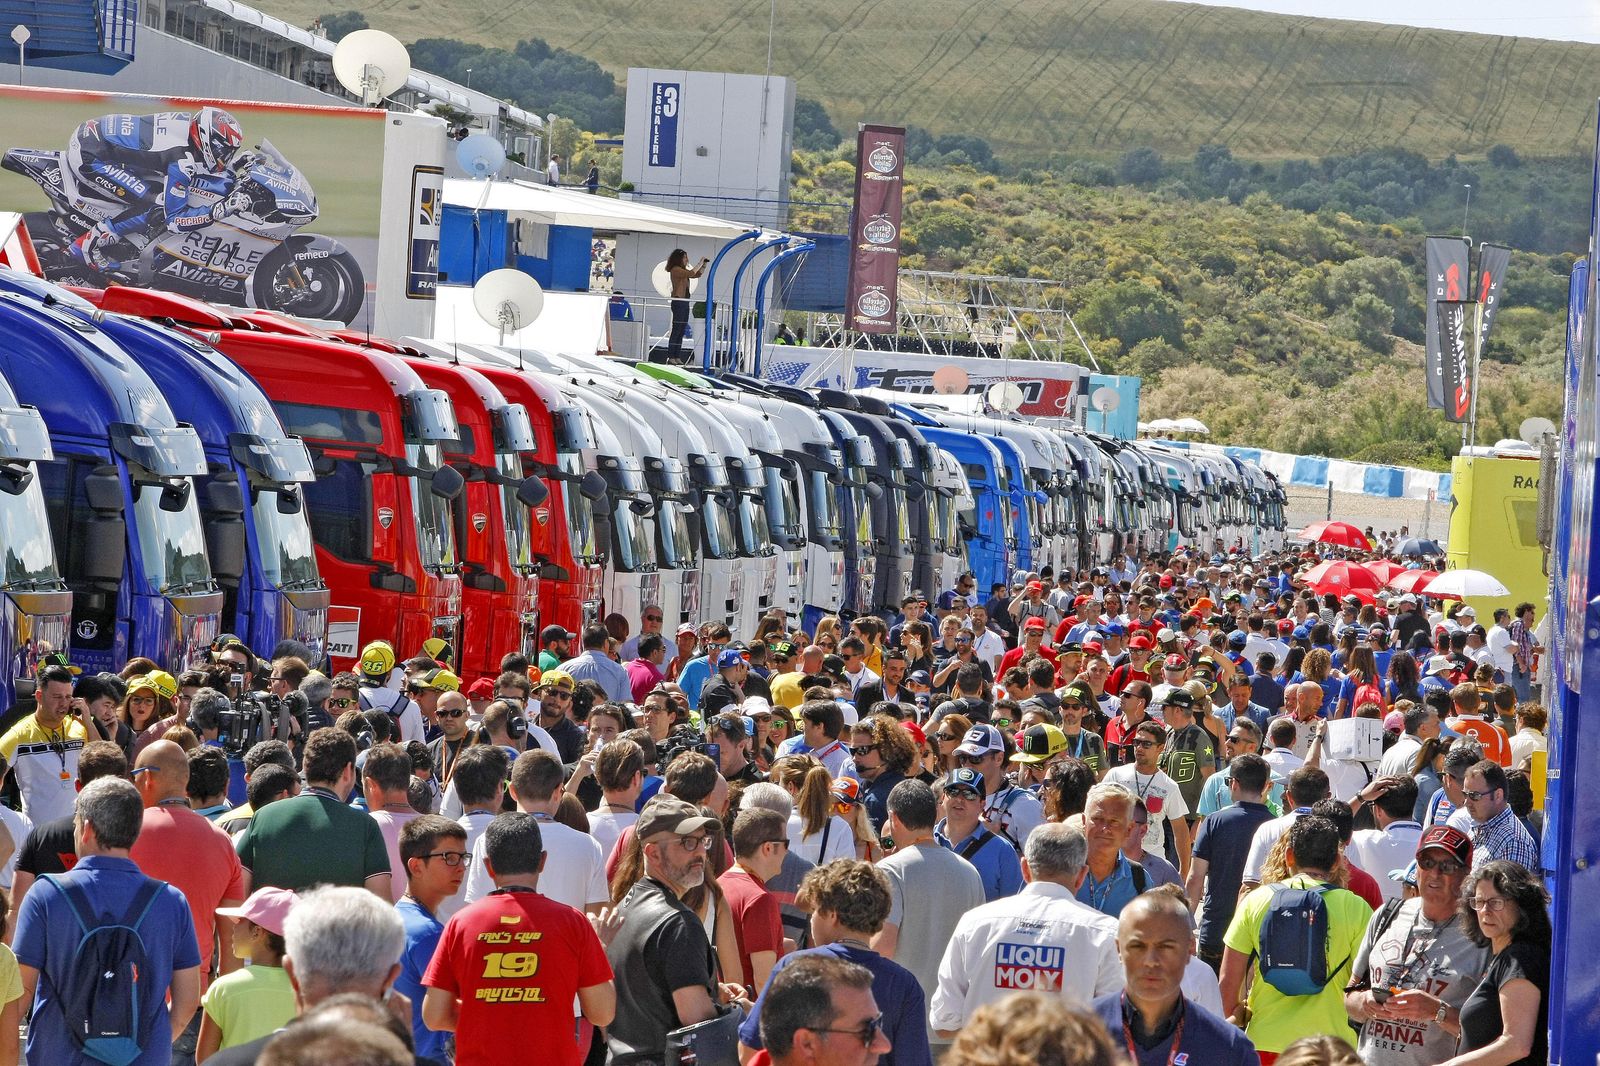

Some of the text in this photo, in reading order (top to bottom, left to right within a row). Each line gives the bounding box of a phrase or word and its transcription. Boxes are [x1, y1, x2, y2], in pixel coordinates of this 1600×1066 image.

[663, 86, 678, 118] 3
[652, 85, 662, 165] ESCALERA
[95, 176, 117, 193] CIRSA
[101, 164, 146, 194] Avintia
[184, 231, 264, 264] REALE
[294, 250, 329, 261] remeco
[161, 259, 240, 290] Avintia
[362, 660, 384, 672] 46
[477, 931, 542, 944] FAN'S CLUB
[482, 952, 538, 978] 19
[997, 944, 1061, 968] LIQUI
[995, 966, 1062, 992] MOLY
[1424, 977, 1449, 998] 17
[475, 987, 546, 1003] BAUTISTA
